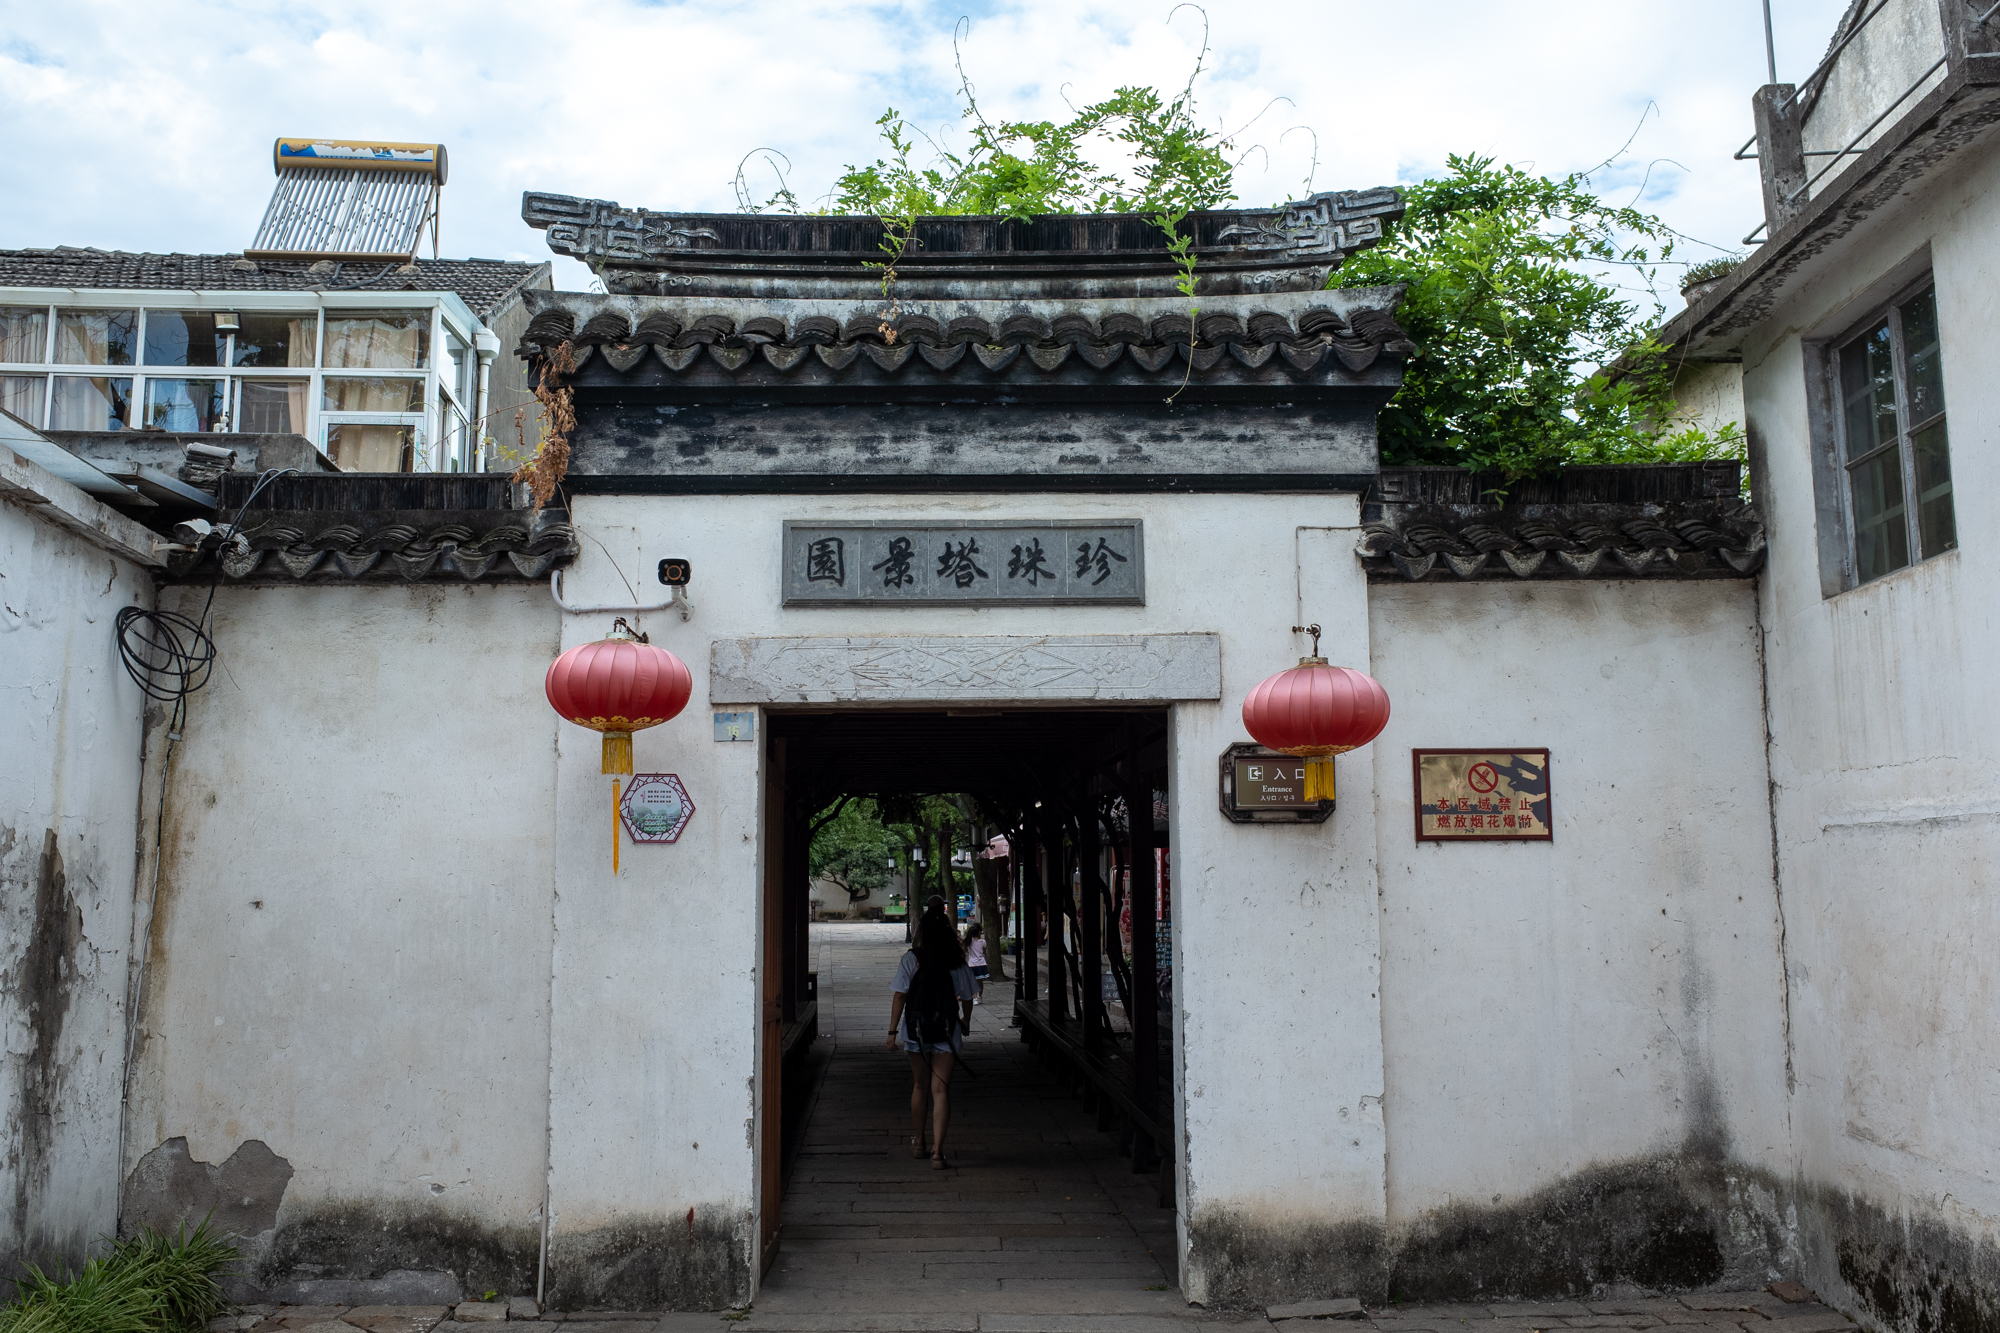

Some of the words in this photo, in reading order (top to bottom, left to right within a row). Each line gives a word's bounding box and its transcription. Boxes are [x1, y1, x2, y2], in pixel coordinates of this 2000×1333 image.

[726, 725, 740, 738] 16
[1273, 768, 1304, 780] 入口
[1437, 797, 1532, 811] 本区域禁止
[1437, 814, 1532, 829] 燃放烟花爆竹
